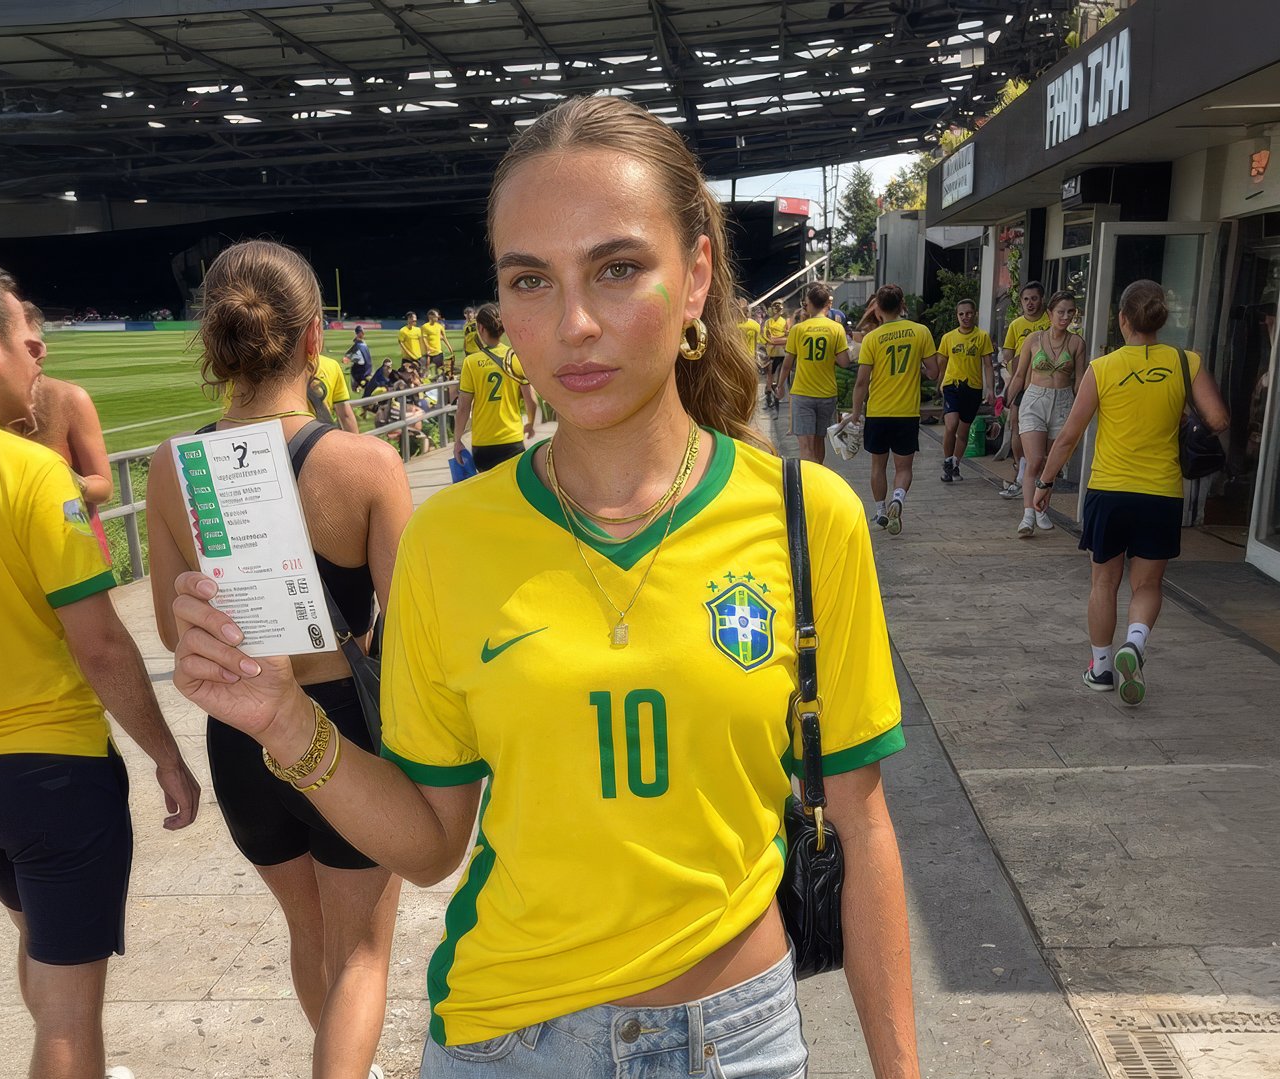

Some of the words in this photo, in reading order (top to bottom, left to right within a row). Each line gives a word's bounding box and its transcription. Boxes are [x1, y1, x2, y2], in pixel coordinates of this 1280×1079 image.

[803, 336, 828, 361] 19
[886, 343, 912, 376] 17
[488, 371, 503, 402] 2
[589, 688, 670, 799] 10
